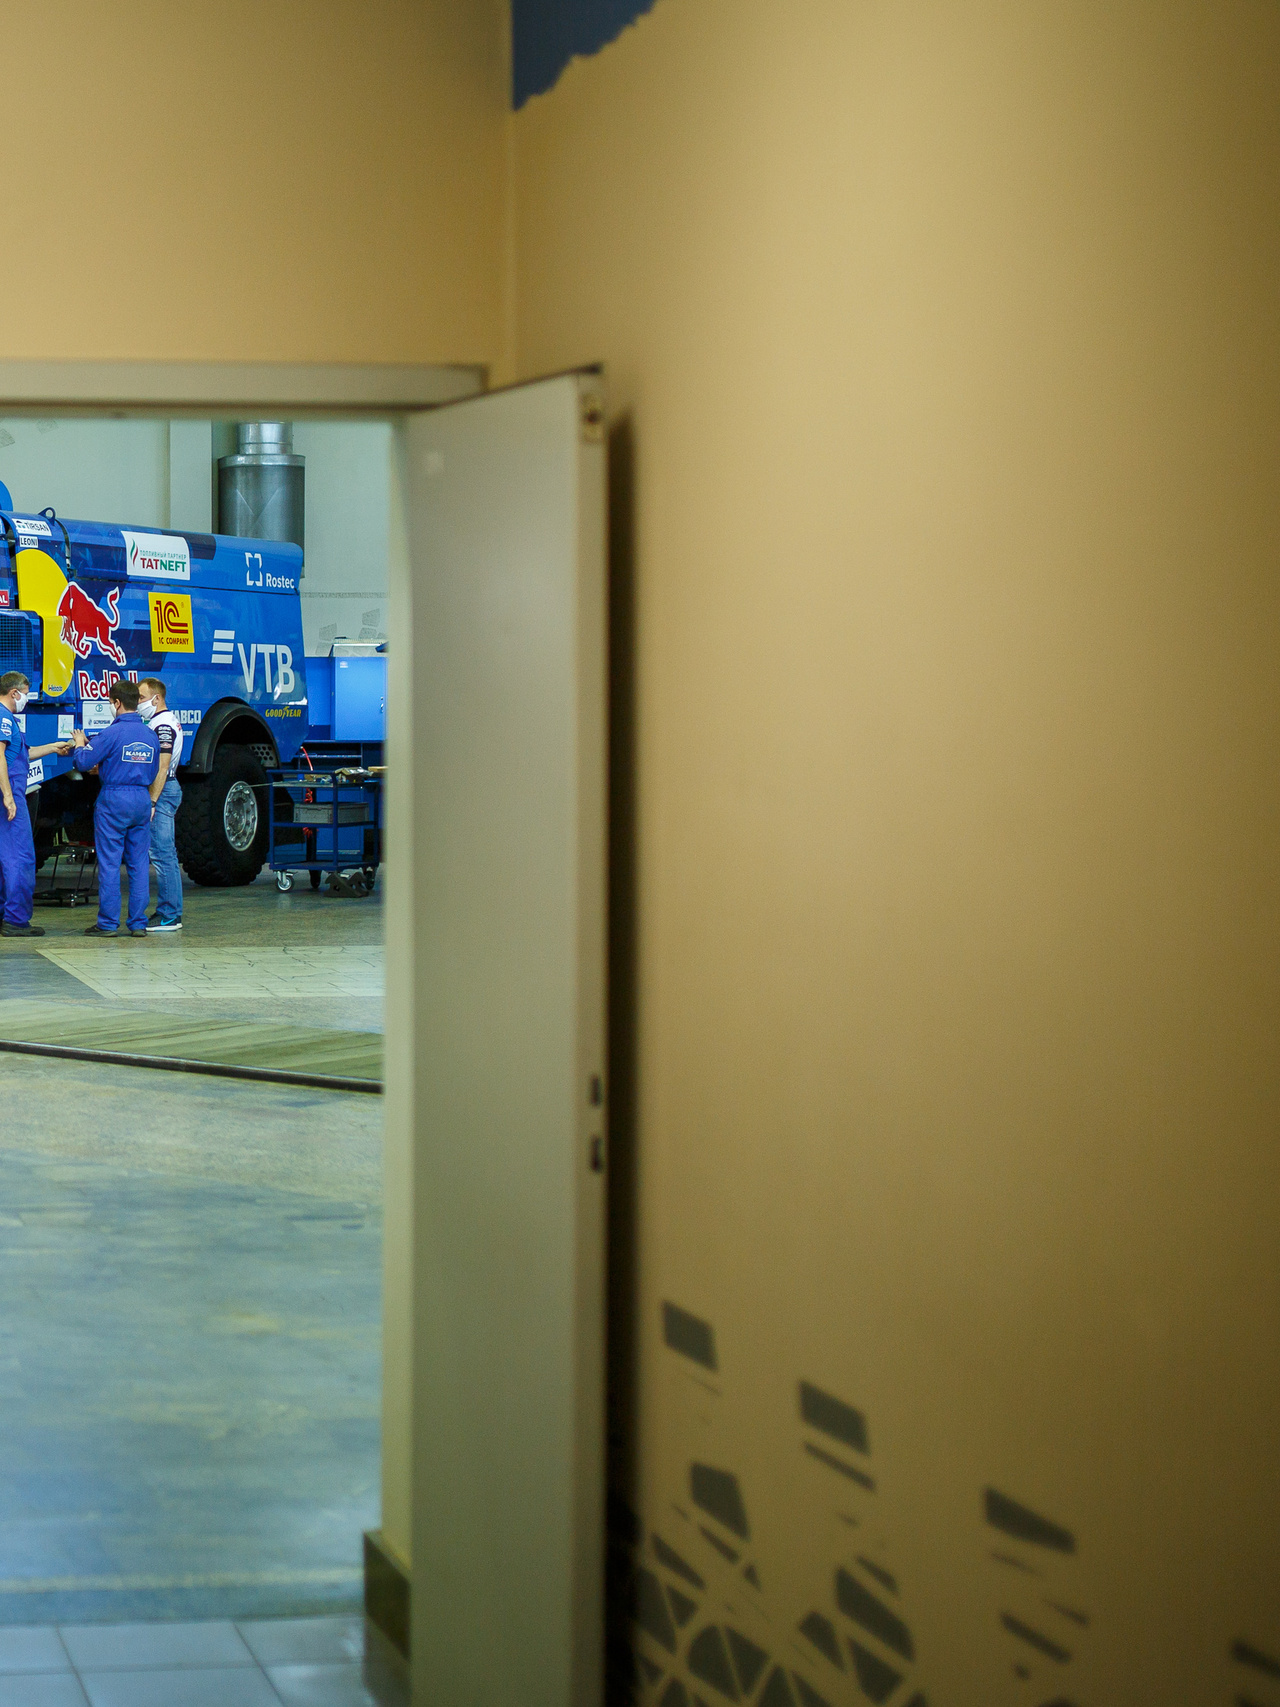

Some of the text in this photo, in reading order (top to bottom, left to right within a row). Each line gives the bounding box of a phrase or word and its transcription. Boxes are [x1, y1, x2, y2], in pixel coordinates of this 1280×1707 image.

[20, 537, 38, 546] LEONI
[140, 557, 187, 572] TATNEFT
[266, 573, 295, 589] Rostec
[166, 637, 189, 645] COMPANY
[237, 643, 296, 693] VTB
[78, 670, 110, 700] Red
[172, 710, 202, 724] ABCO
[265, 706, 301, 719] GOODYEAR
[27, 766, 42, 778] RTA
